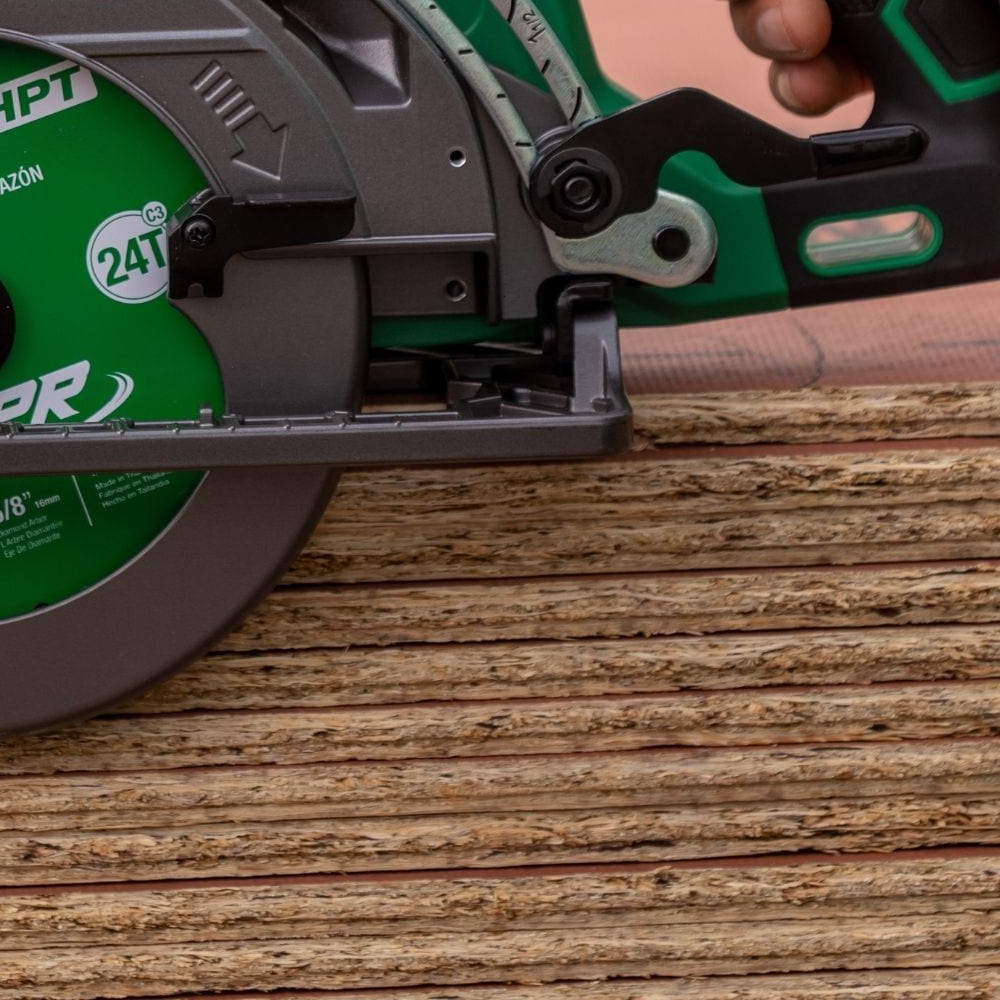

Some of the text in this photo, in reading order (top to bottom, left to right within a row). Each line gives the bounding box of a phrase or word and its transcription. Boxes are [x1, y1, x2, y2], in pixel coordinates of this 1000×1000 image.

[145, 206, 165, 222] C3
[97, 228, 166, 287] 24T
[35, 494, 61, 509] 16mm
